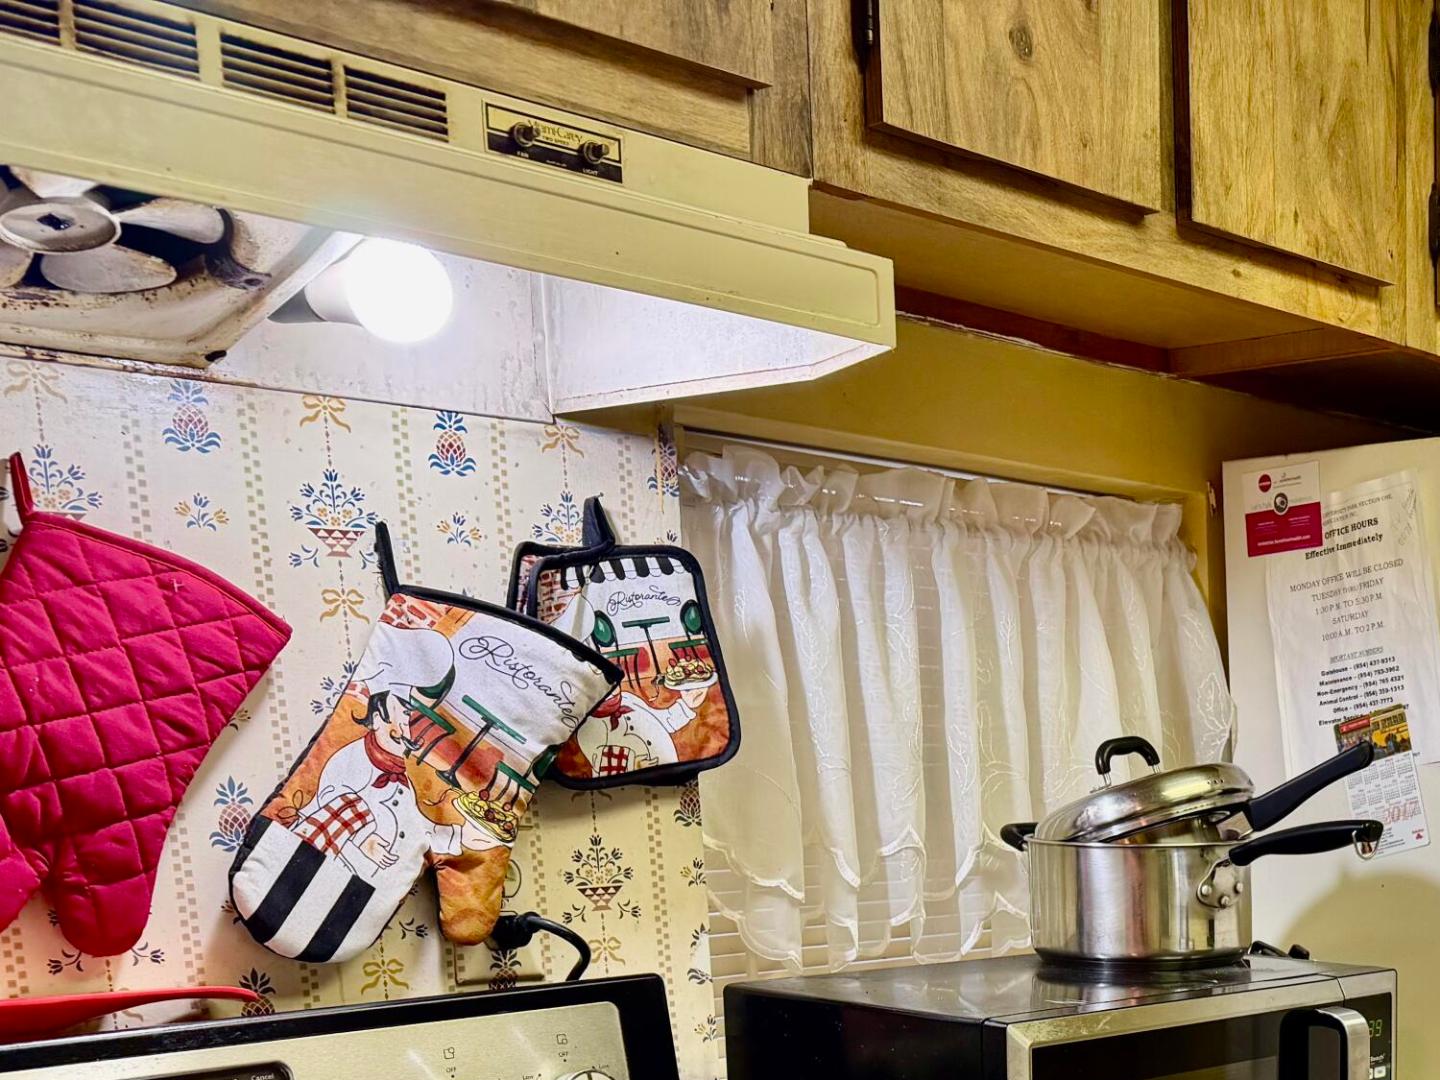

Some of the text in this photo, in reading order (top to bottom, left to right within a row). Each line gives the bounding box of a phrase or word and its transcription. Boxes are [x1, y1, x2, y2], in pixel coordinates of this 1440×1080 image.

[1325, 525, 1350, 540] OFFICE
[1350, 517, 1379, 532] HOURS
[1305, 532, 1384, 560] Effective Immediately
[1290, 580, 1320, 592] MONDAY
[1373, 558, 1404, 571] CLOSED
[607, 586, 682, 616] Ristorante
[1312, 589, 1342, 602] TUESDAY
[1359, 577, 1384, 590] FRIDAY
[1344, 599, 1354, 608] TO
[1332, 610, 1369, 625] SATURDAY
[1355, 625, 1365, 633] TO
[459, 635, 580, 731] Ristorante
[1339, 694, 1359, 703] Control
